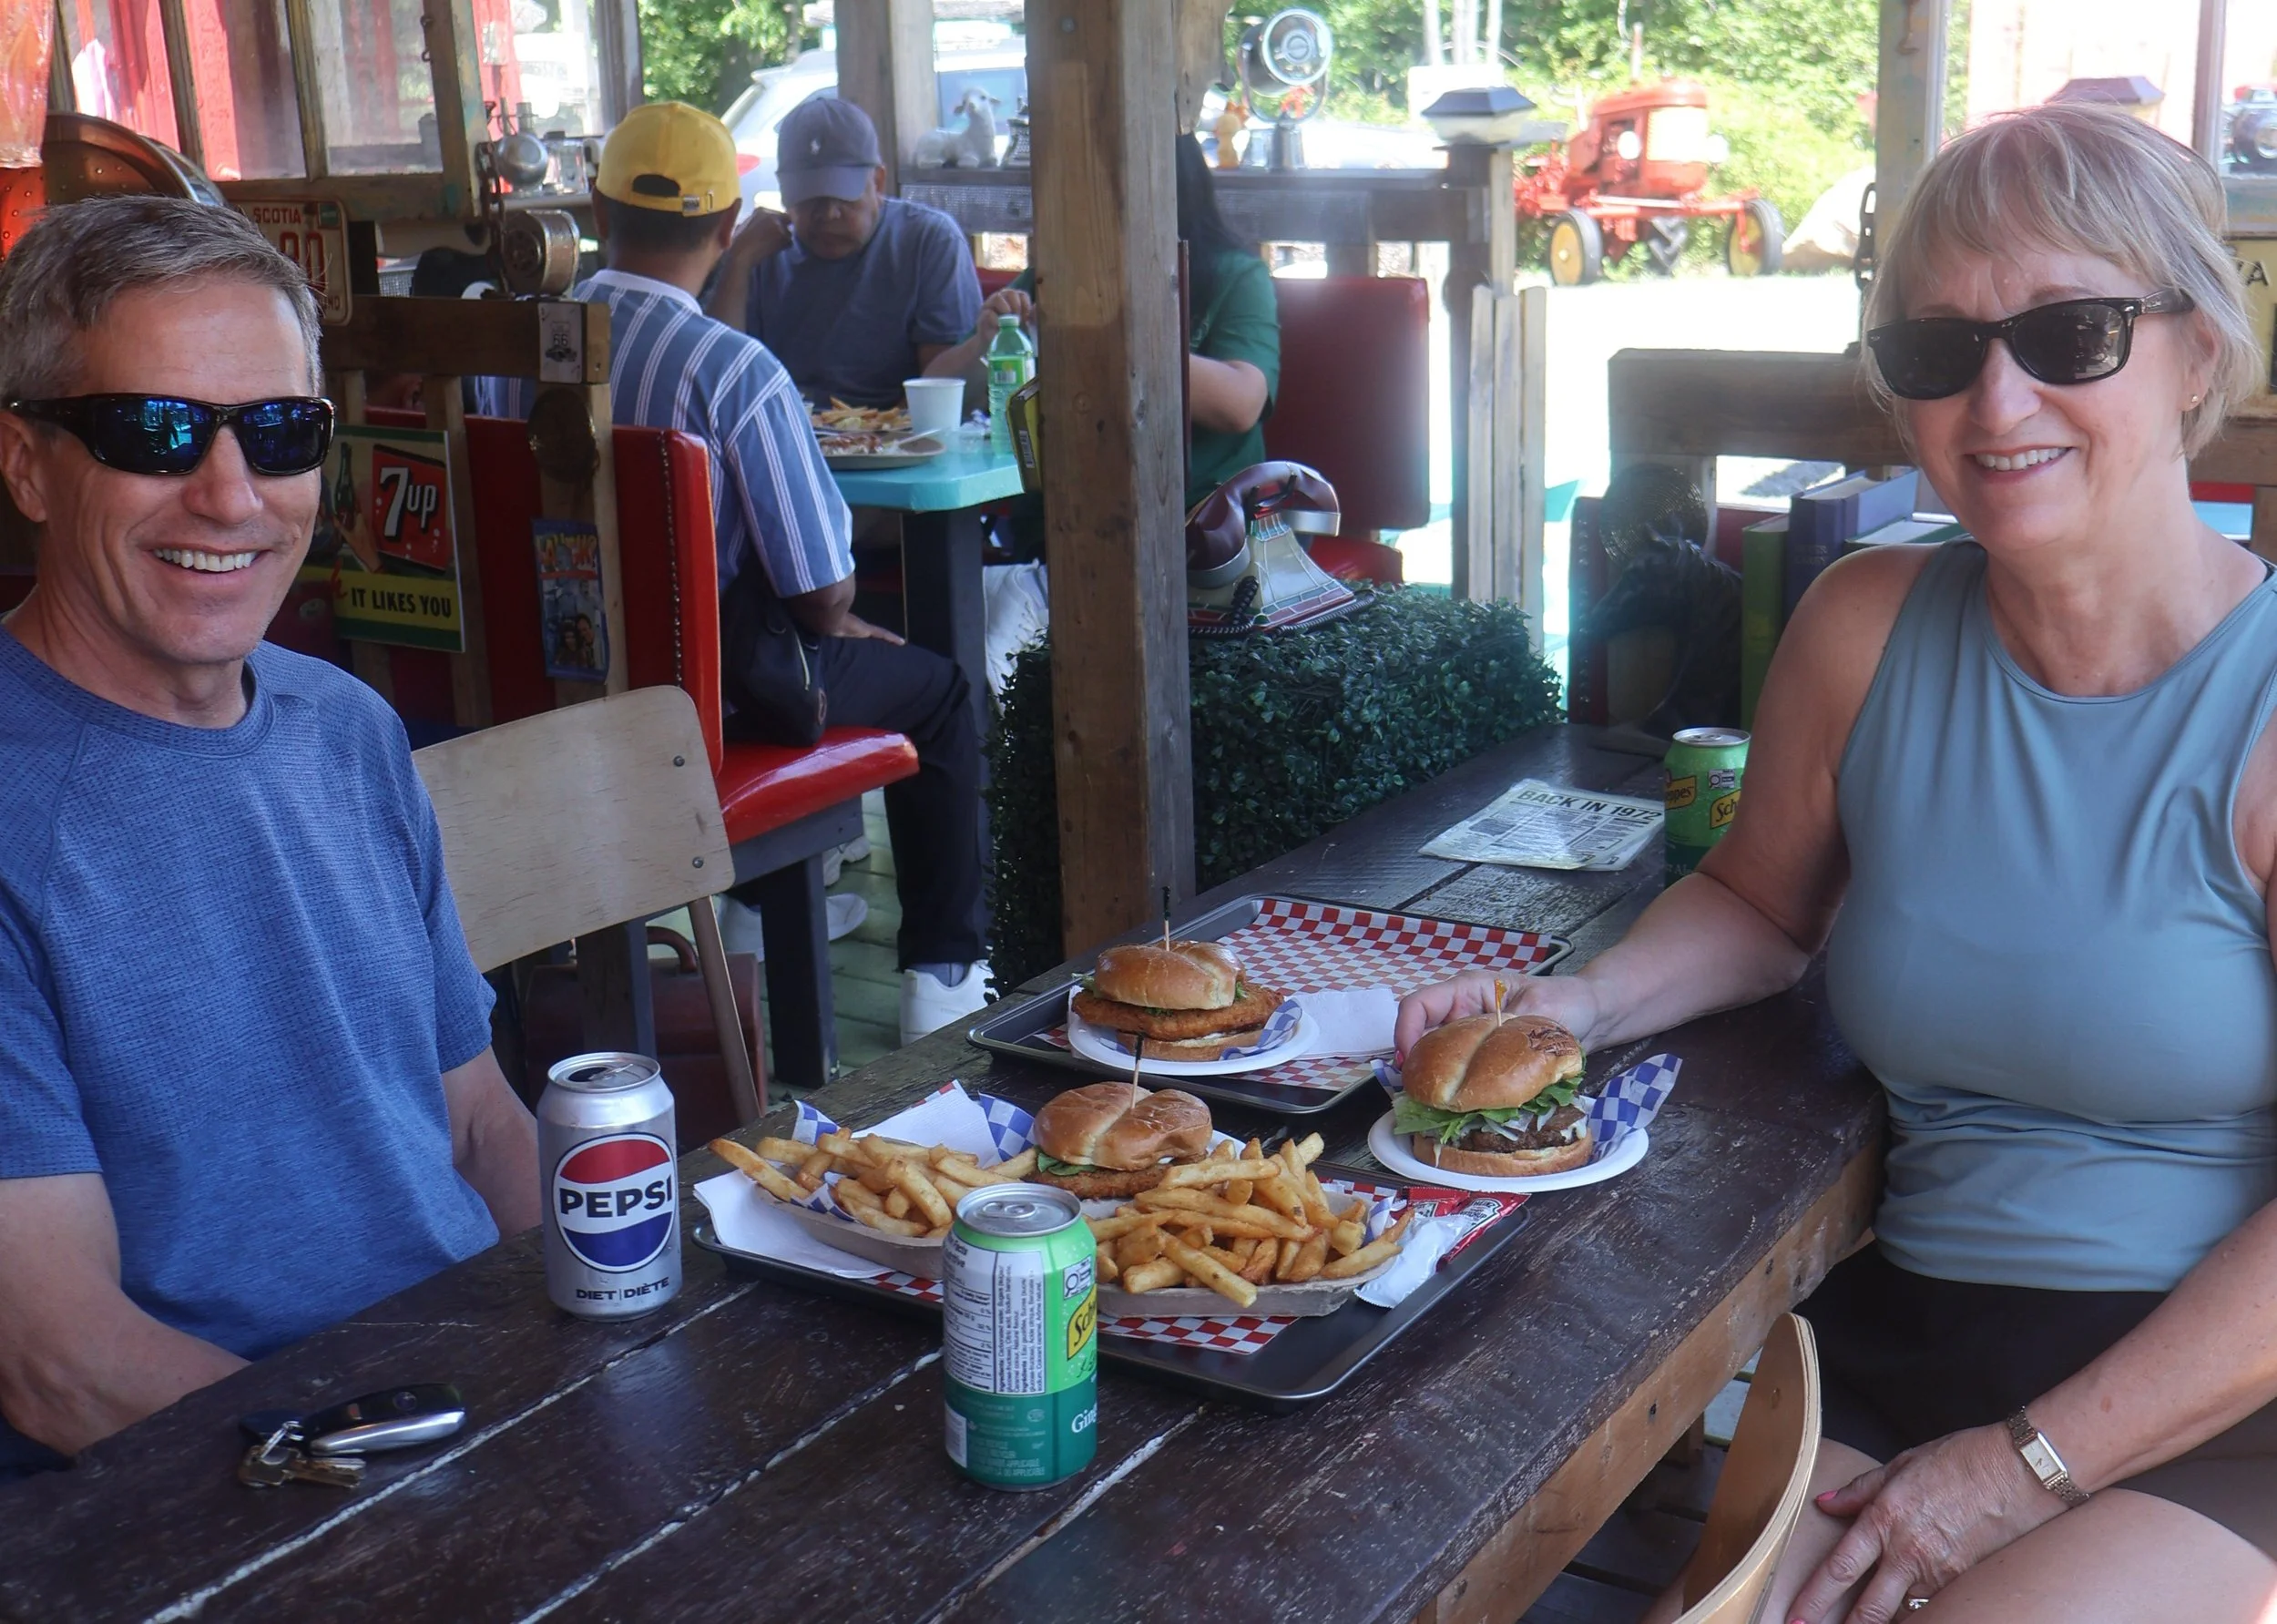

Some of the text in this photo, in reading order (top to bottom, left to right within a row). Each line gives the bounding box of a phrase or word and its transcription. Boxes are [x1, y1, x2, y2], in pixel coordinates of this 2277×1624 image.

[253, 208, 301, 224] SCOTIA
[351, 587, 367, 608] IT
[372, 589, 416, 614] LIKES
[419, 595, 452, 618] YOU
[1516, 790, 1578, 808] BACK
[1579, 801, 1608, 812] IN
[1608, 806, 1663, 821] 1972
[559, 1173, 672, 1218] PEPSI
[1473, 1200, 1496, 1209] HEINZ
[576, 1277, 669, 1300] DIET DIÈTE
